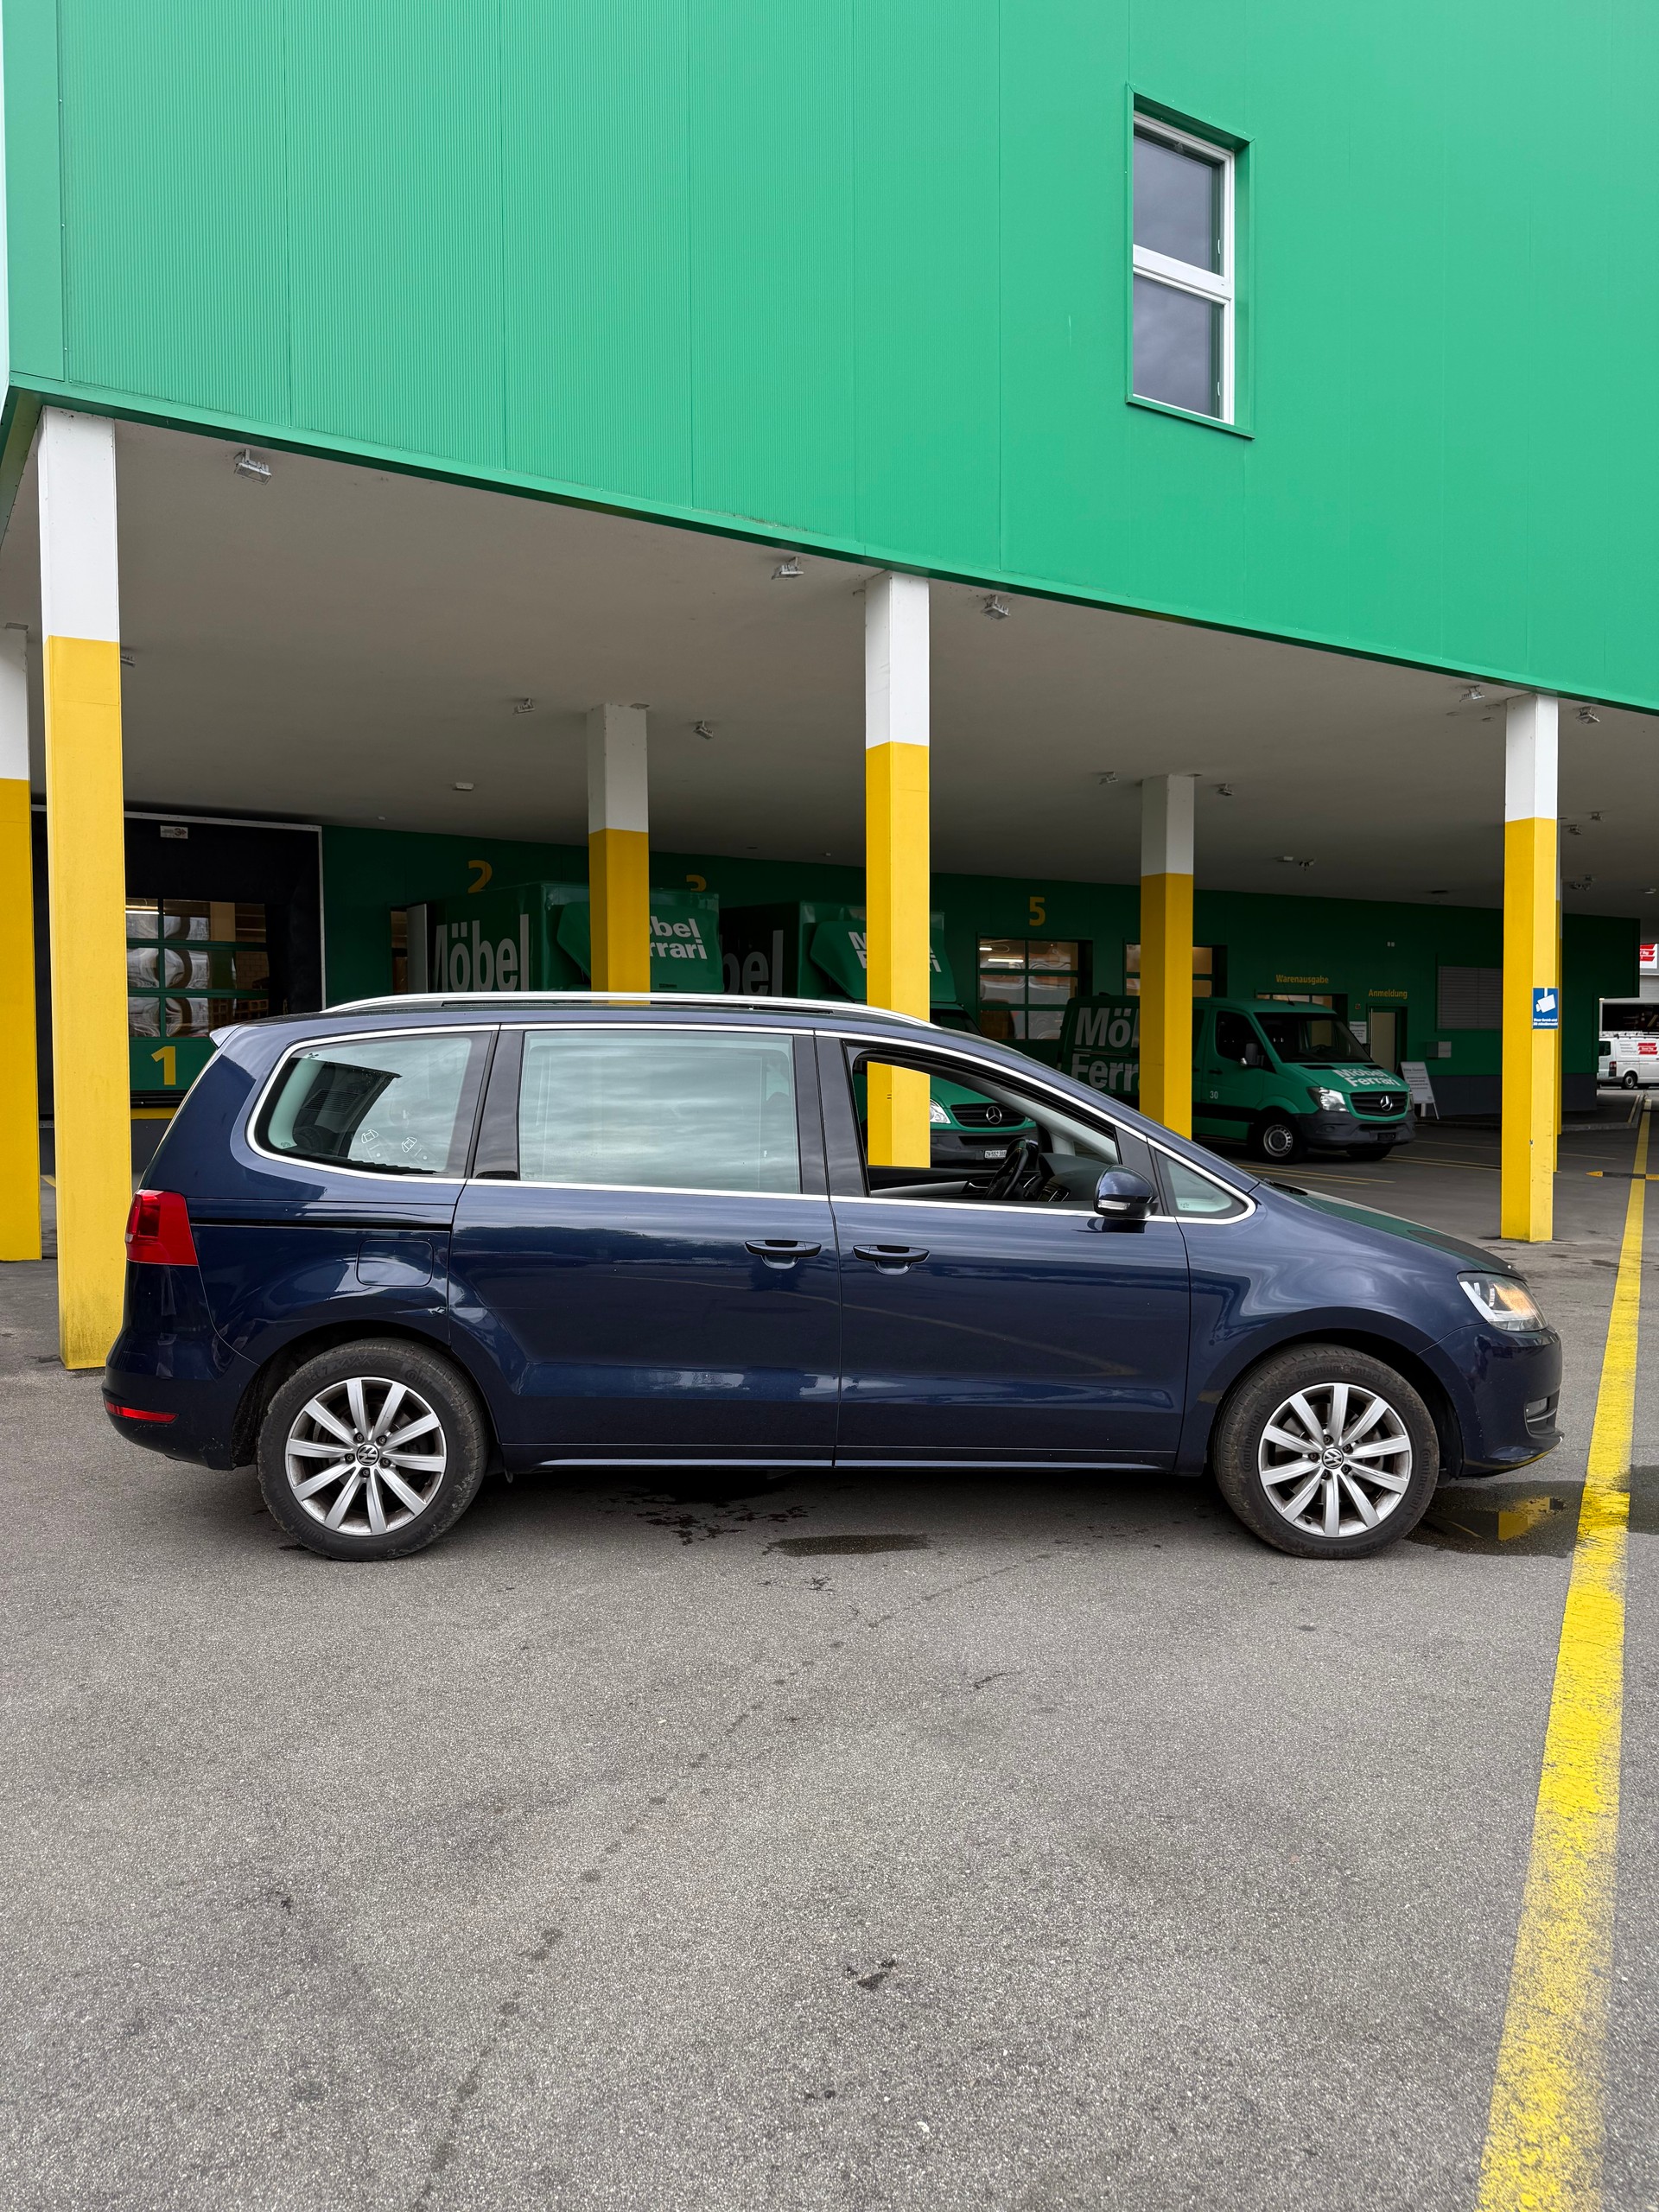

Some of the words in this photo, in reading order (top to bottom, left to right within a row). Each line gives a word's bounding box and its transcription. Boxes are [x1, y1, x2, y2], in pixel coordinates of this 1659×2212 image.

[467, 860, 493, 893] 2
[1028, 896, 1046, 926] 5
[650, 916, 701, 938] bel
[650, 938, 709, 960] rrari
[1276, 974, 1329, 986] Warenausgabe
[1368, 988, 1408, 1000] Anmeldung
[151, 1046, 175, 1085] 1
[1071, 1048, 1139, 1092] Ferr
[1332, 1068, 1389, 1078] Möbel
[1344, 1077, 1402, 1087] Ferrari
[1210, 1090, 1218, 1099] 30
[1297, 1364, 1382, 1381] PremiumContact
[1242, 1409, 1262, 1472] Continental
[1410, 1448, 1431, 1510] Continental
